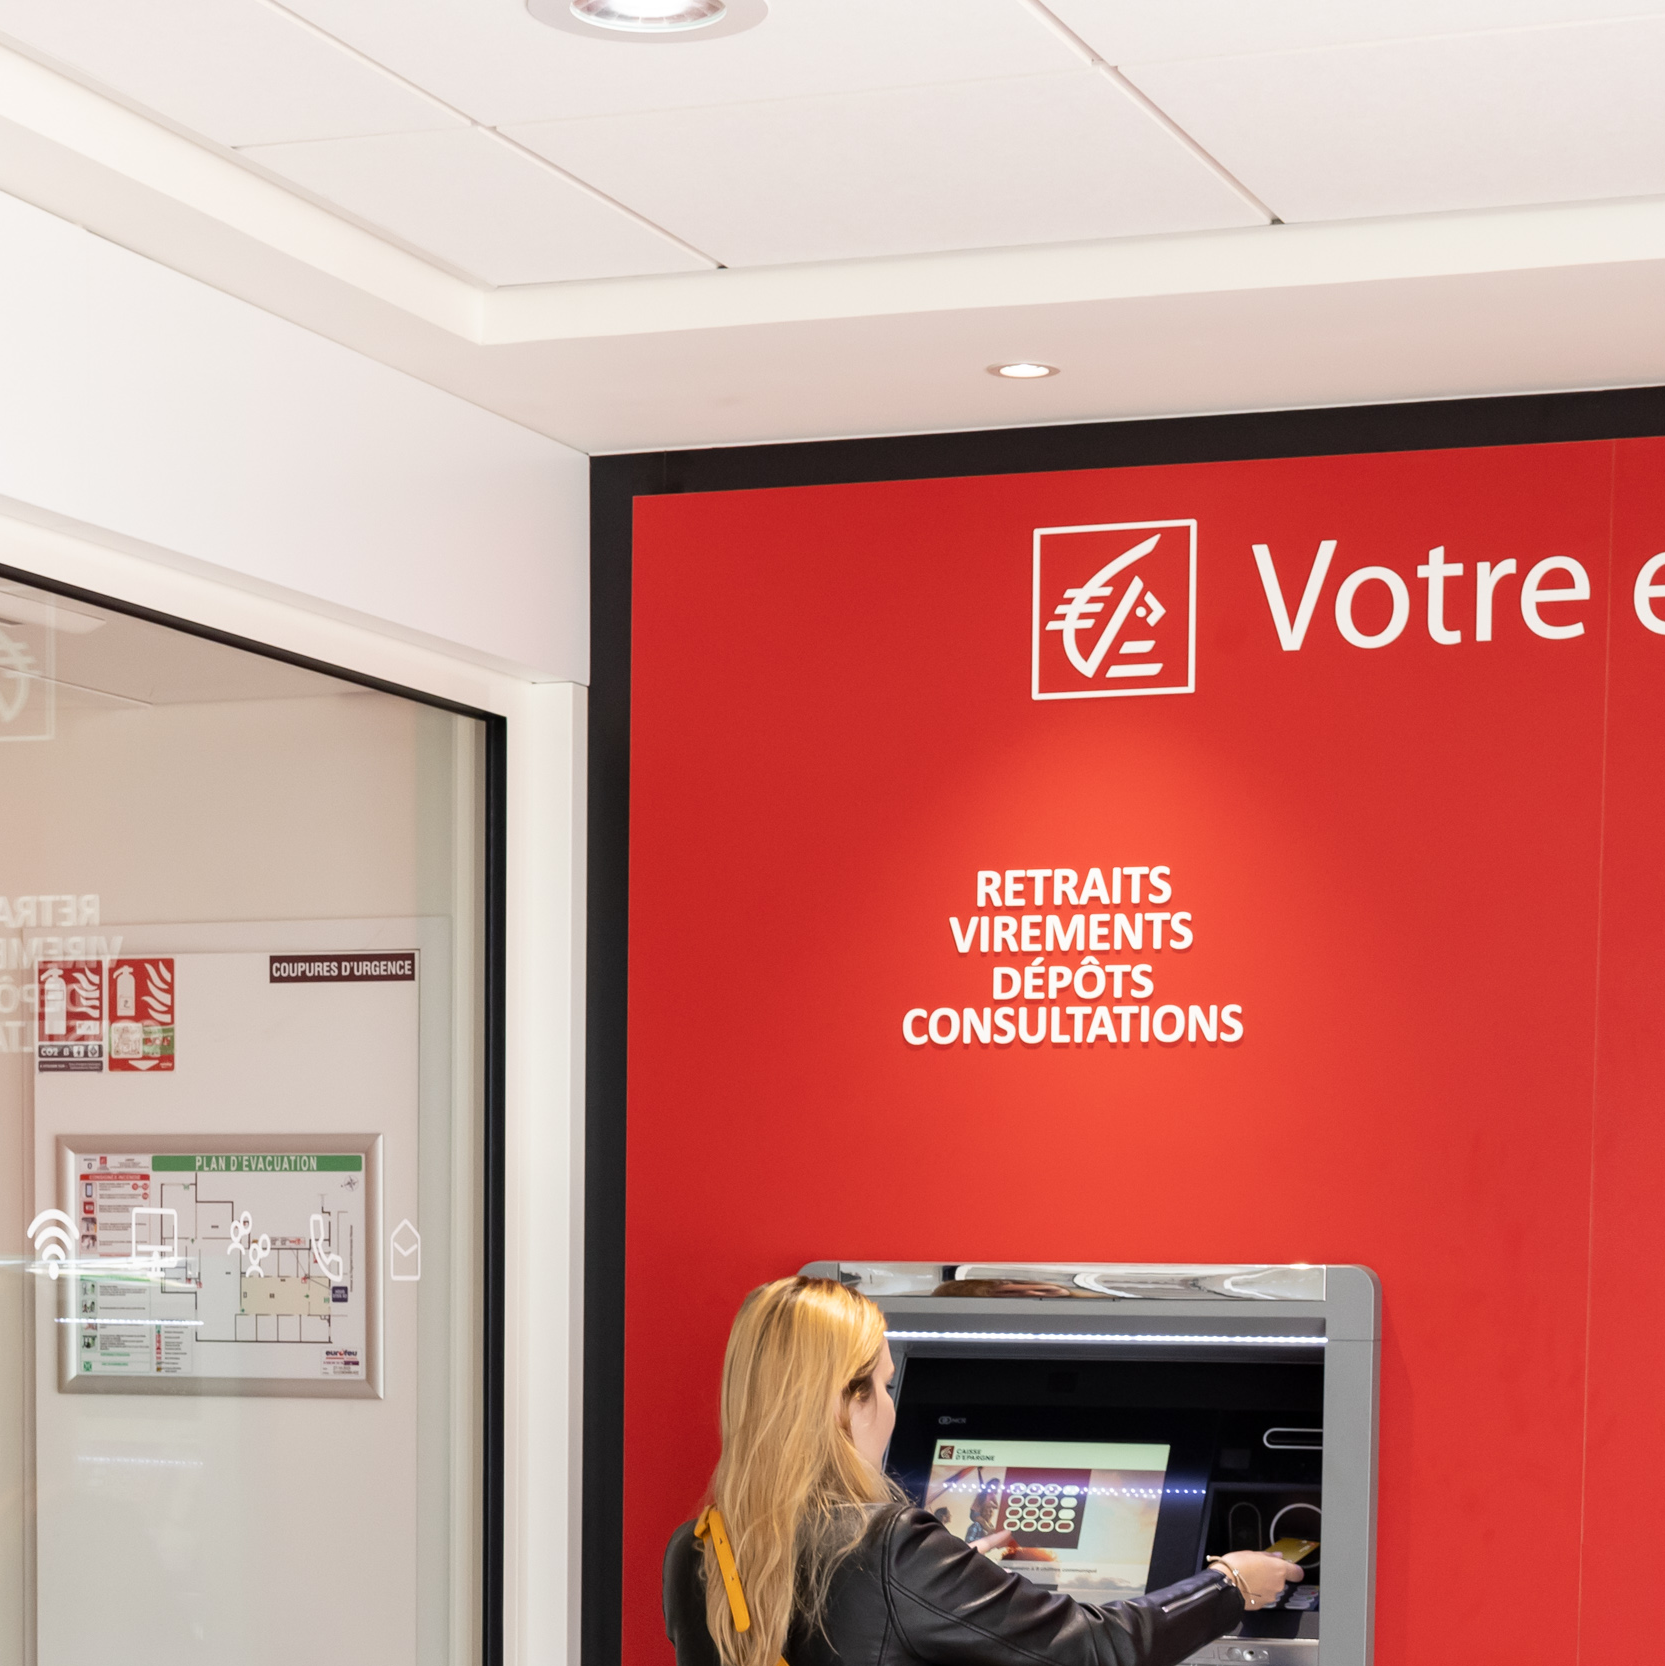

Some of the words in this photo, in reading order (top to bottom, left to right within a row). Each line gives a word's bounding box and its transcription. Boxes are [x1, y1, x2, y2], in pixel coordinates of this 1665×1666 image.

[1251, 540, 1590, 652] Votre
[977, 866, 1172, 907] RETRAITS
[949, 912, 1194, 953] VIREMENTS
[272, 962, 338, 977] COUPURES
[341, 960, 412, 976] D'URGENCE
[992, 955, 1154, 1000] DÉPÔTS
[902, 1004, 1244, 1046] CONSULTATIONS
[41, 1047, 58, 1056] CO2
[195, 1156, 226, 1171] PLAN
[230, 1156, 317, 1171] D'EVACUATION
